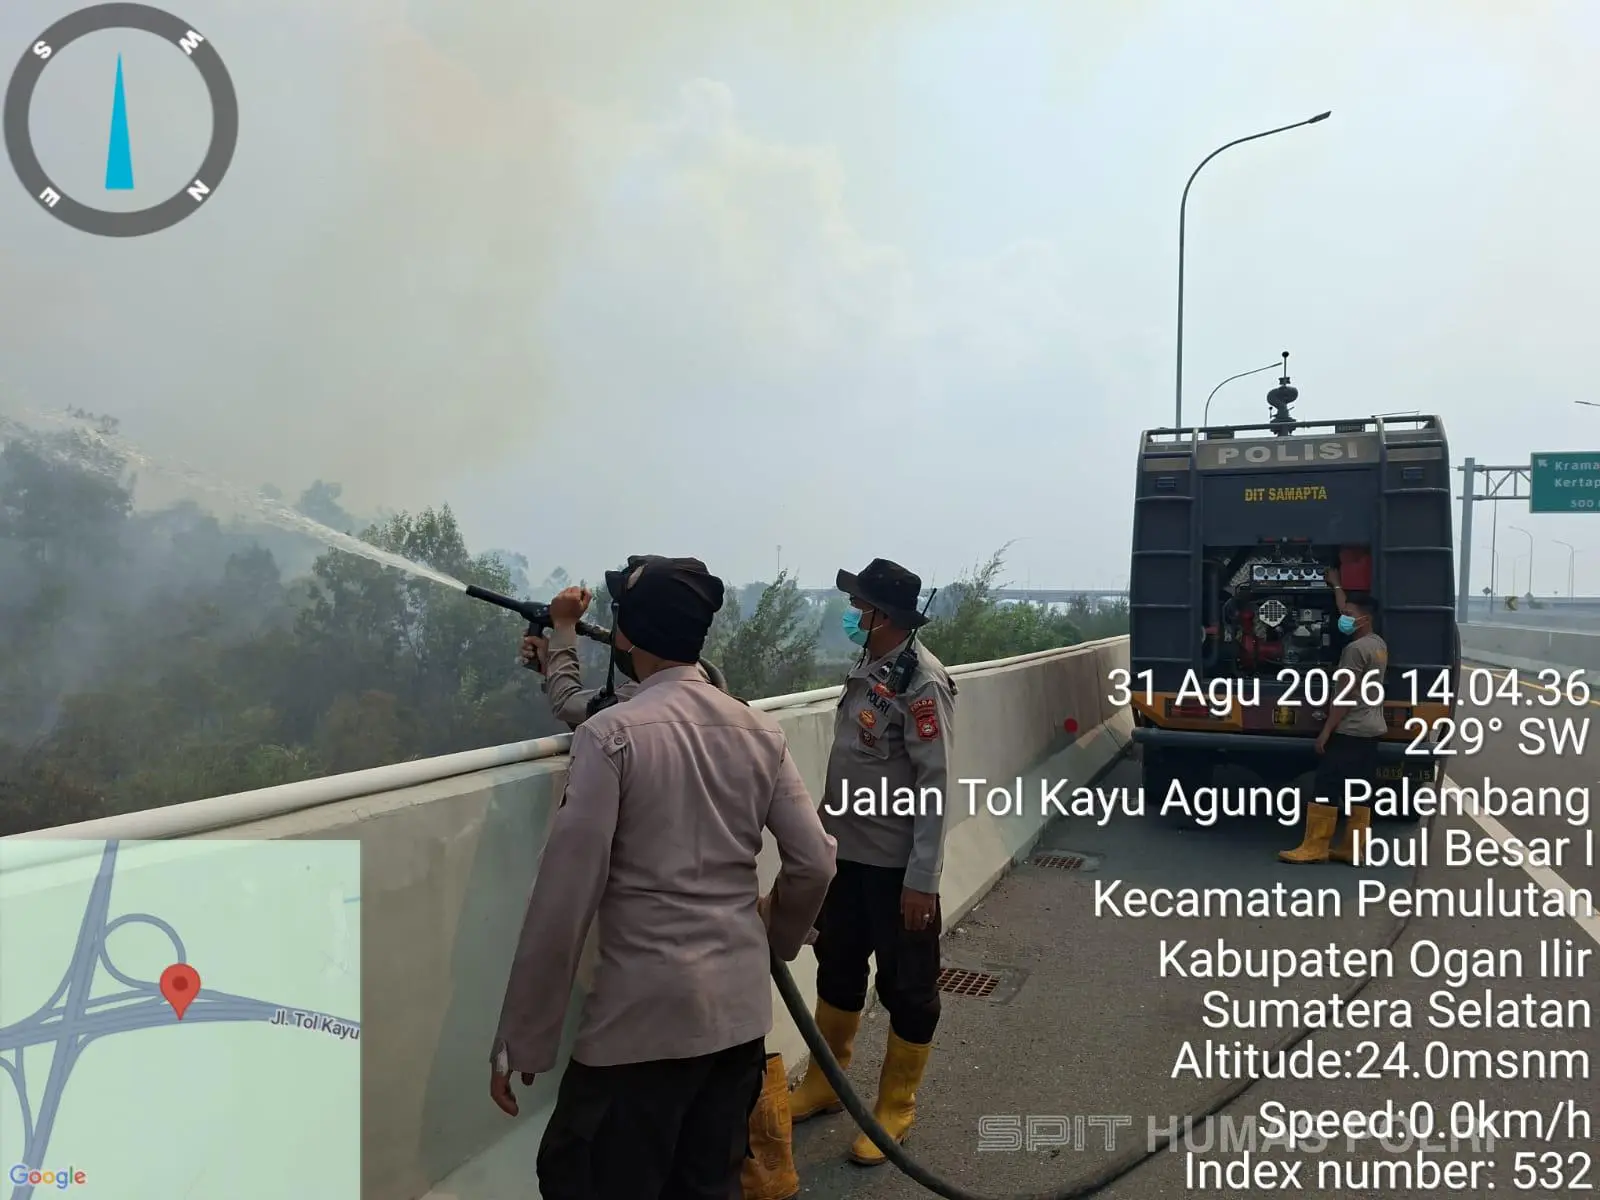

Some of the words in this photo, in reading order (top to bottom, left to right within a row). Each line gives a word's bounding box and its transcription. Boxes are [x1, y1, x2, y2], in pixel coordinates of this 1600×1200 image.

[1217, 442, 1358, 465] POLISI
[1245, 488, 1265, 501] DIT
[1268, 486, 1328, 501] SAMAPTA
[1570, 499, 1594, 508] 500
[865, 687, 891, 714] POLRI
